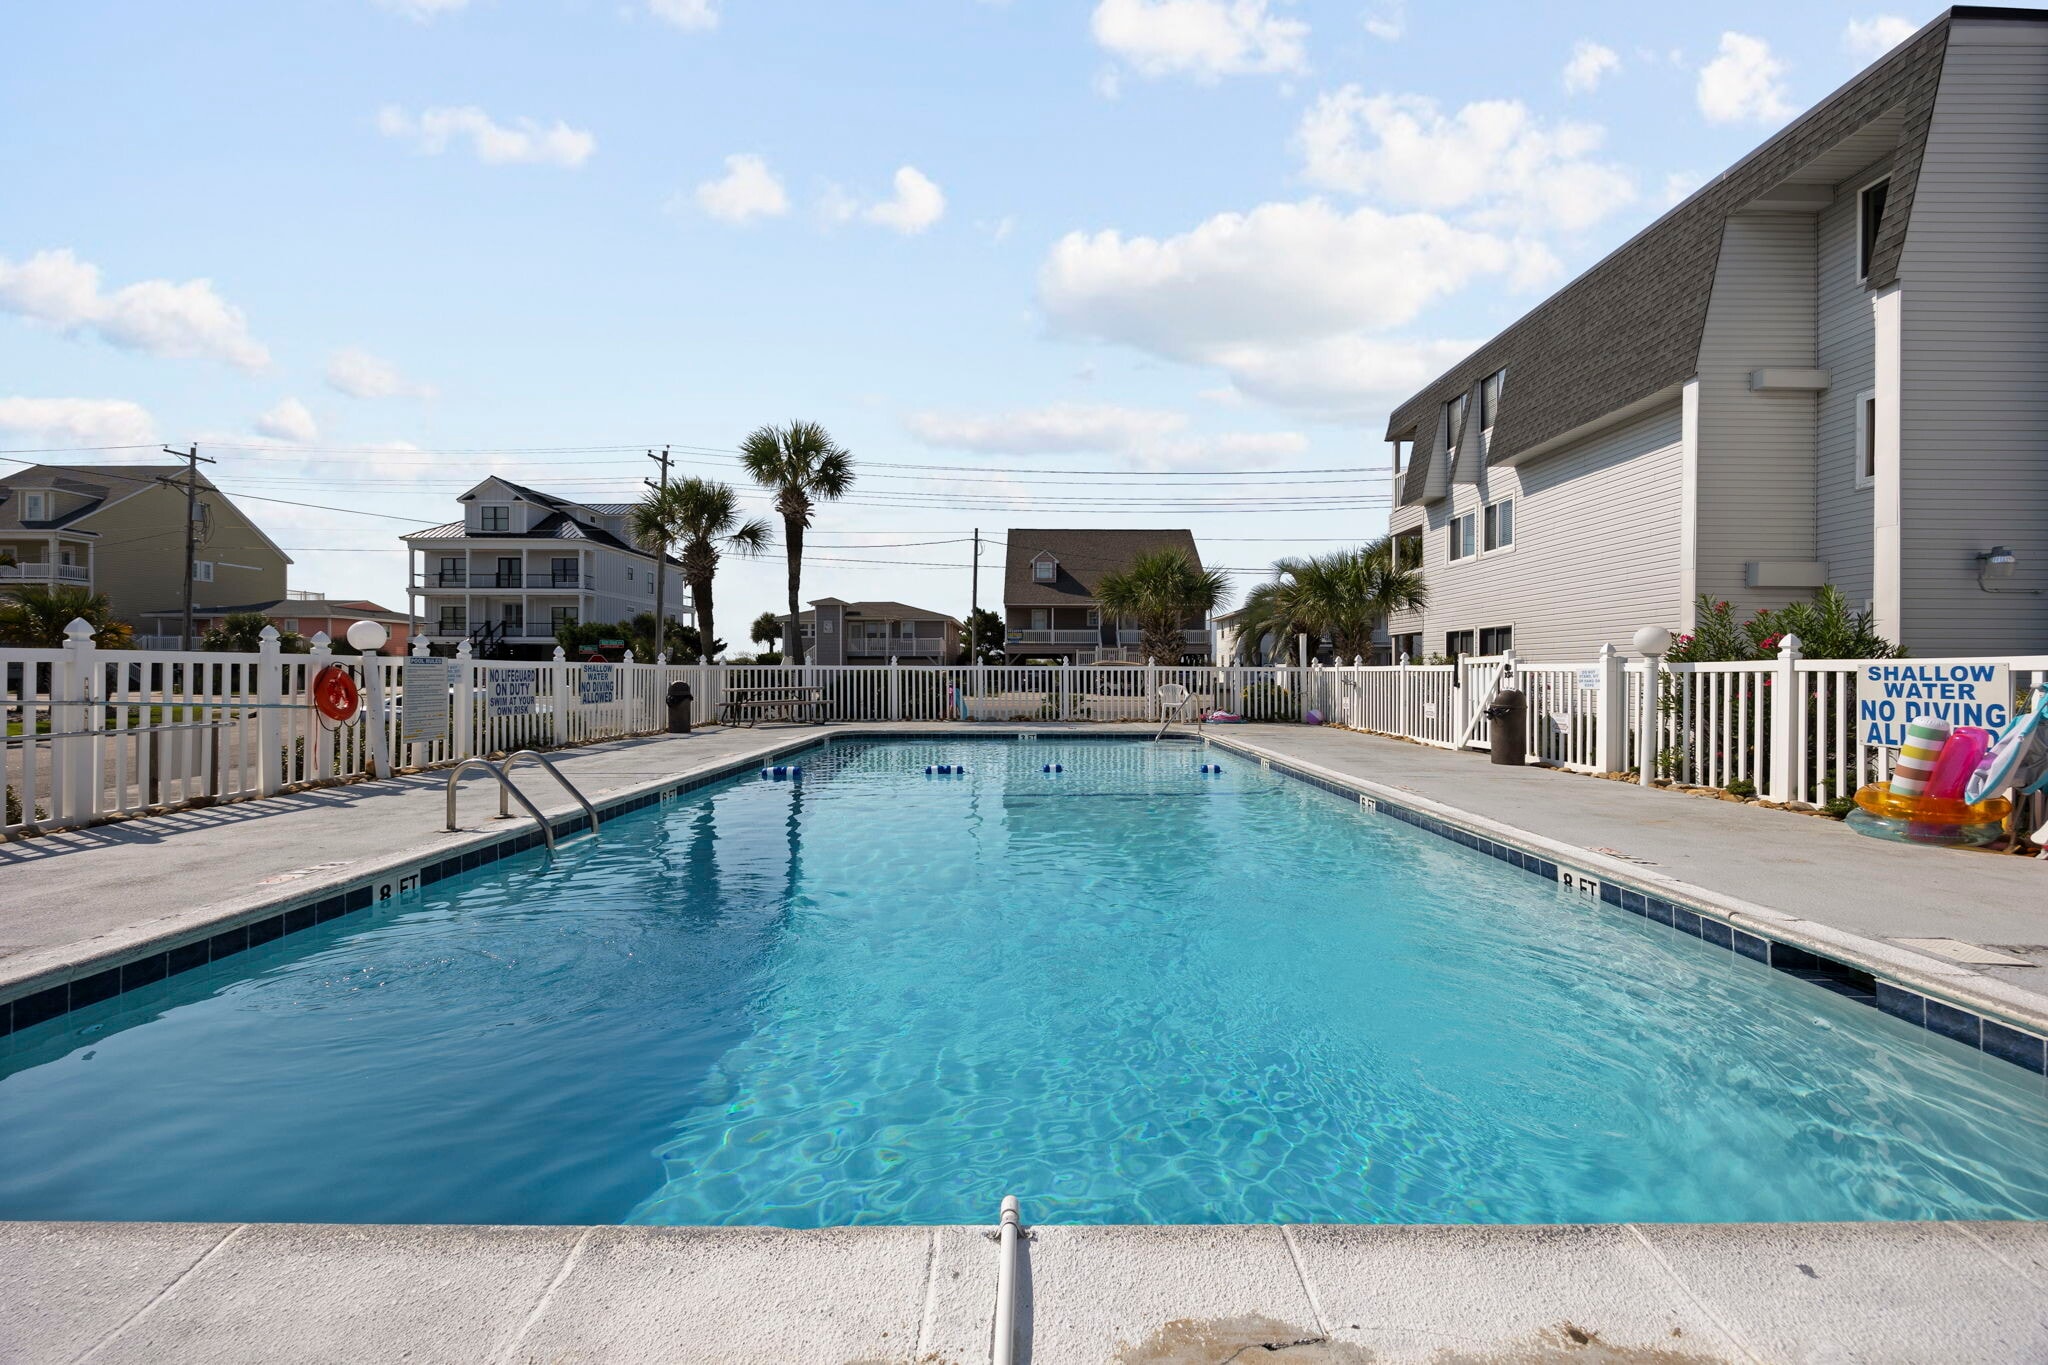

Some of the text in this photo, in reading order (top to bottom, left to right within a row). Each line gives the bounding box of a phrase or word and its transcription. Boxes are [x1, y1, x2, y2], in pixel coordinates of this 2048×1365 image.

[489, 668, 535, 682] NO LIFEGUARD
[583, 665, 613, 673] SHALLOW
[1868, 665, 1995, 682] SHALLOW
[587, 673, 609, 681] WATER
[495, 683, 530, 697] ON DUTY
[581, 681, 614, 693] NO DIVING
[1884, 683, 1976, 700] WATER
[490, 696, 535, 707] SWIM AT YOUR
[582, 692, 613, 704] ALLOWED
[496, 706, 529, 716] OWN RISK
[1861, 700, 2006, 728] NO DIVING
[379, 874, 418, 901] 8 FT
[1563, 873, 1597, 896] 8 FT
